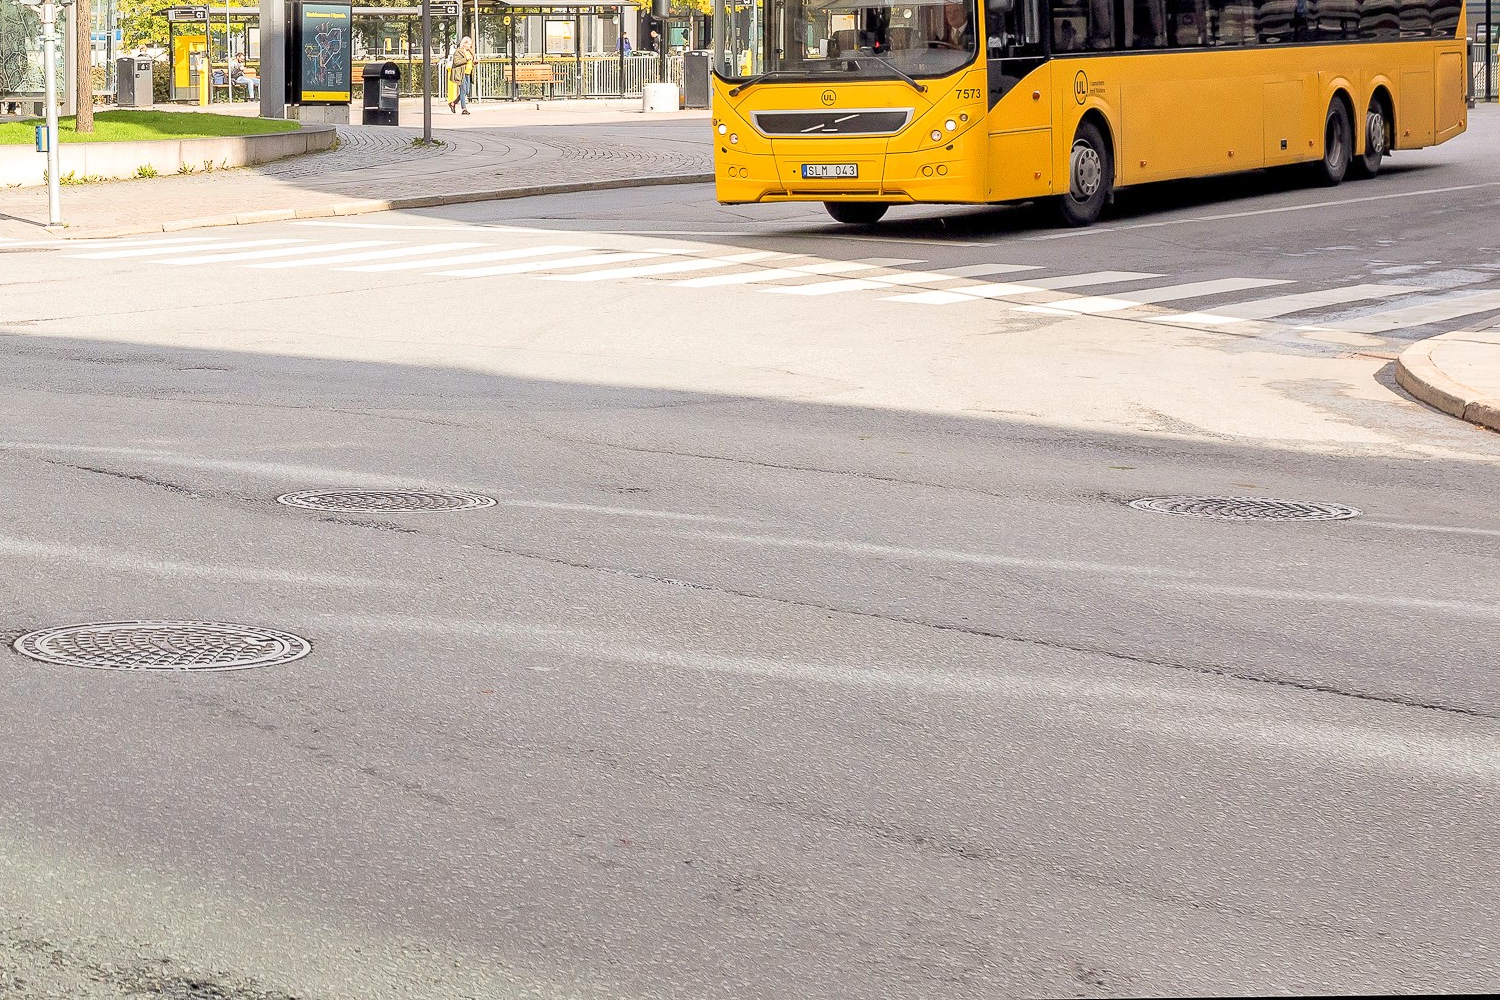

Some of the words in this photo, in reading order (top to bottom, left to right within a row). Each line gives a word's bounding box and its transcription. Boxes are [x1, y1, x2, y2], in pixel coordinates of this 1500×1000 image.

[1076, 80, 1086, 95] UL
[955, 88, 981, 99] 7573
[808, 166, 828, 176] SLM
[835, 165, 855, 176] 043
